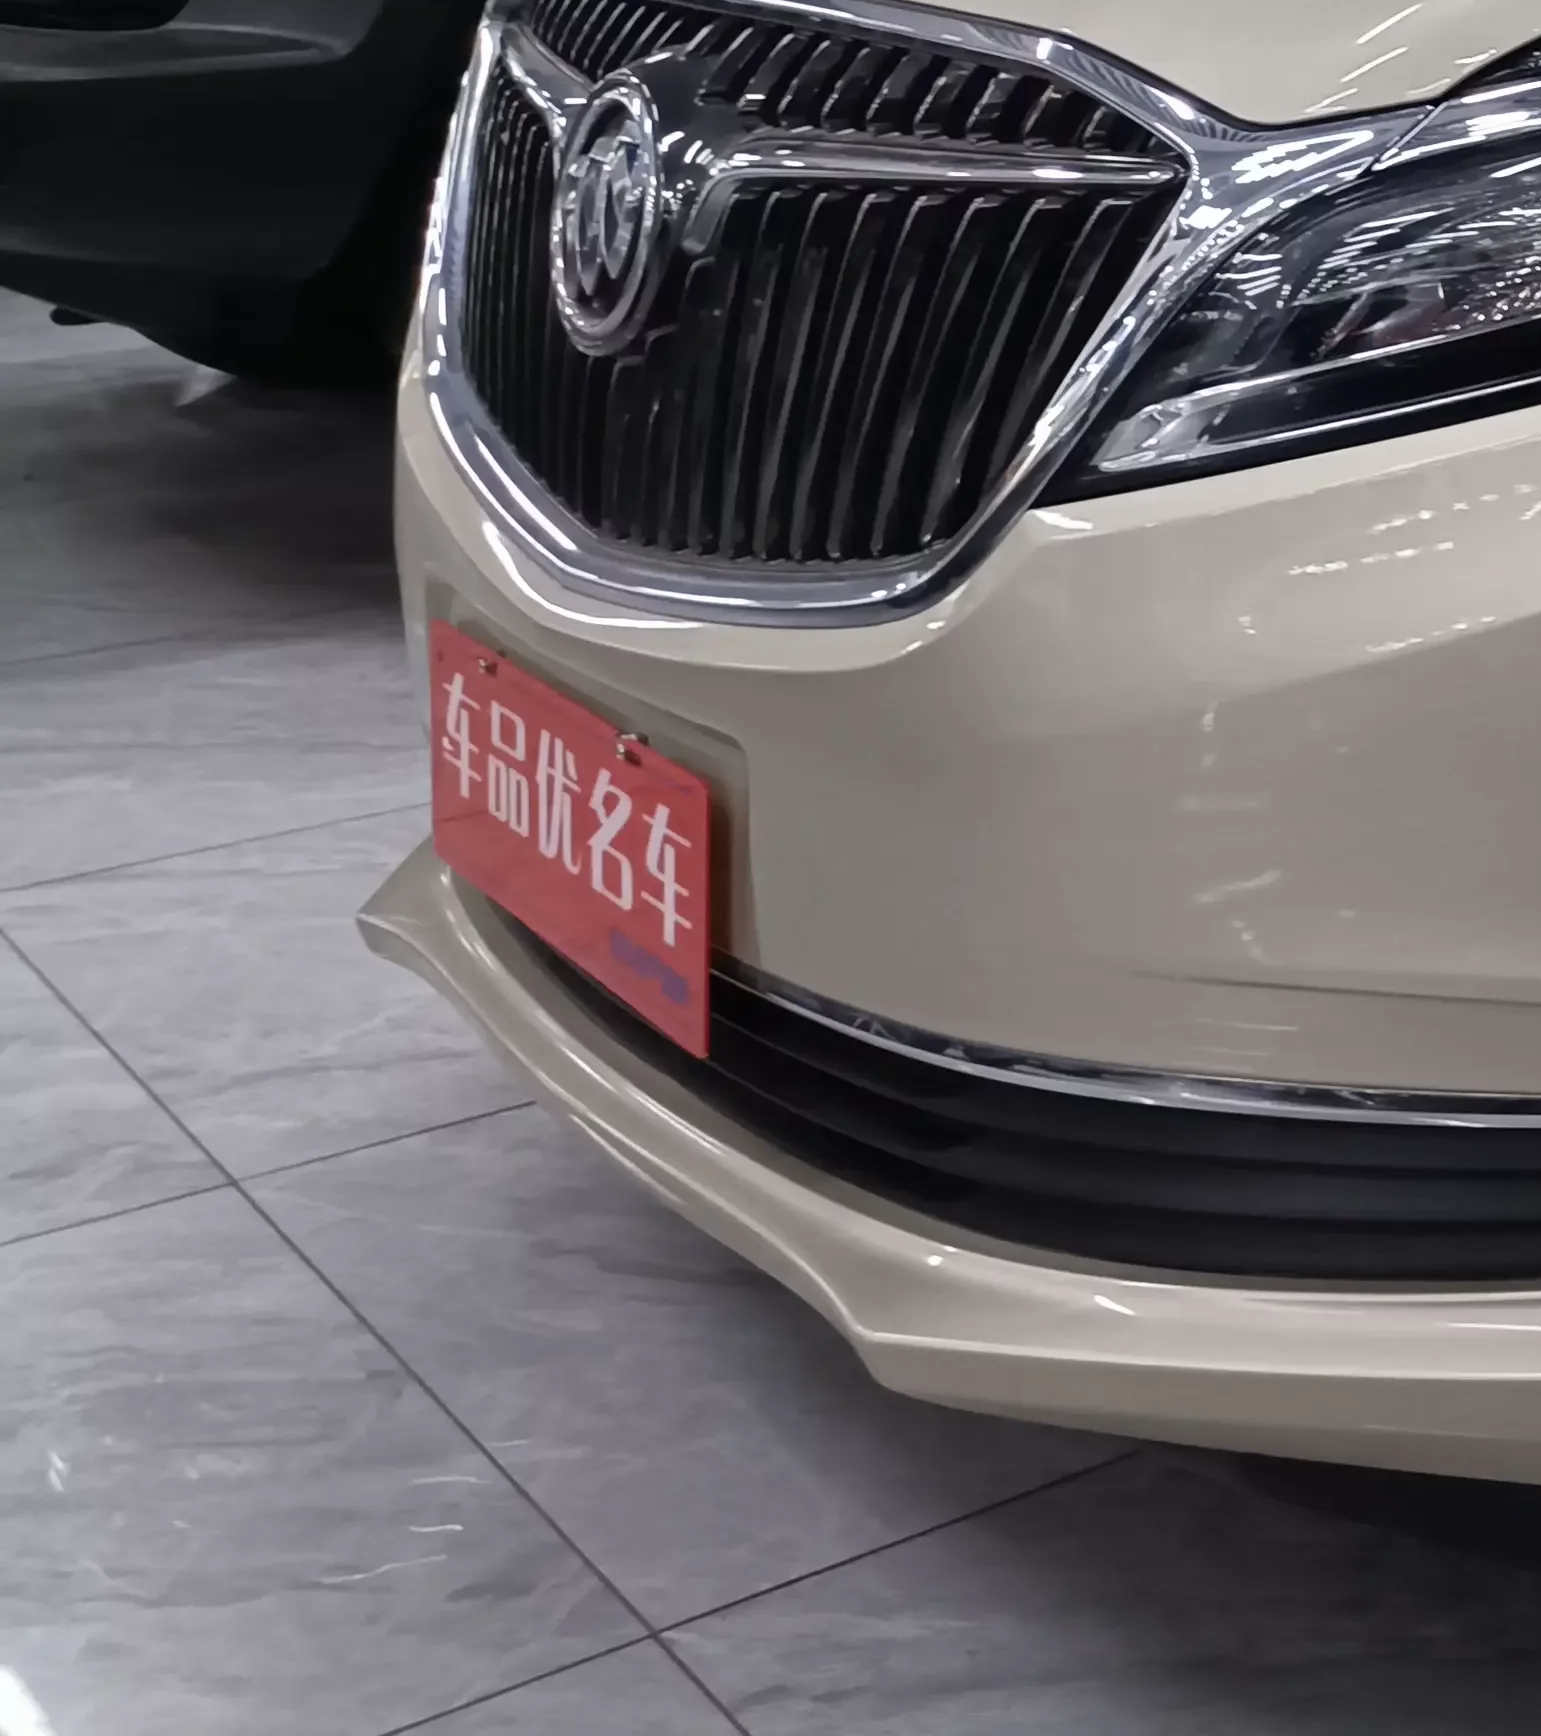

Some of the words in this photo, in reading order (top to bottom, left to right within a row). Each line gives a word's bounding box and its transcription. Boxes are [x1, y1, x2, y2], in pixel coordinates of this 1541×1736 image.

[443, 672, 693, 947] 车品优名车
